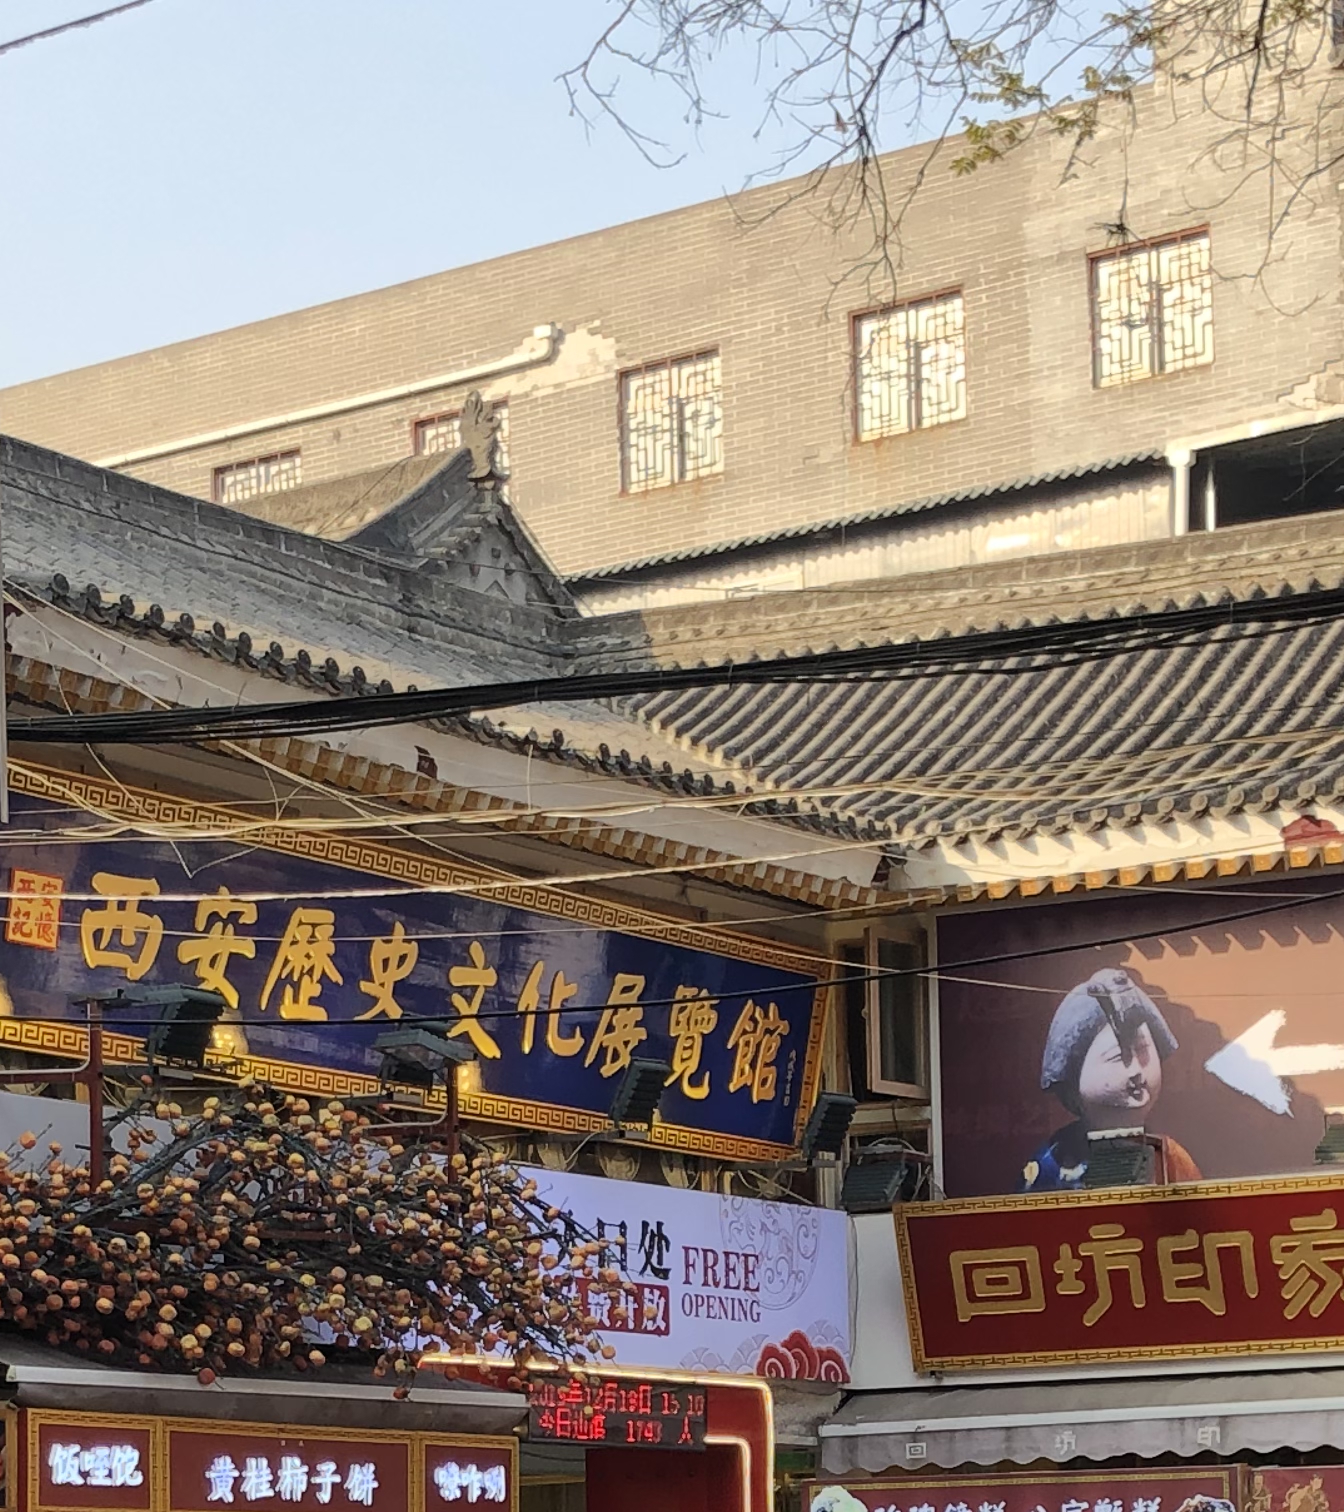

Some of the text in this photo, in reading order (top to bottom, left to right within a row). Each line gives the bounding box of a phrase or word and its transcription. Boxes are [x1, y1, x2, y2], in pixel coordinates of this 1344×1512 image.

[79, 871, 790, 1105] 西安歷史文化展覽館
[682, 1246, 760, 1292] FREE
[681, 1293, 761, 1323] OPENING
[205, 1455, 379, 1506] 黄桂柿子饼
